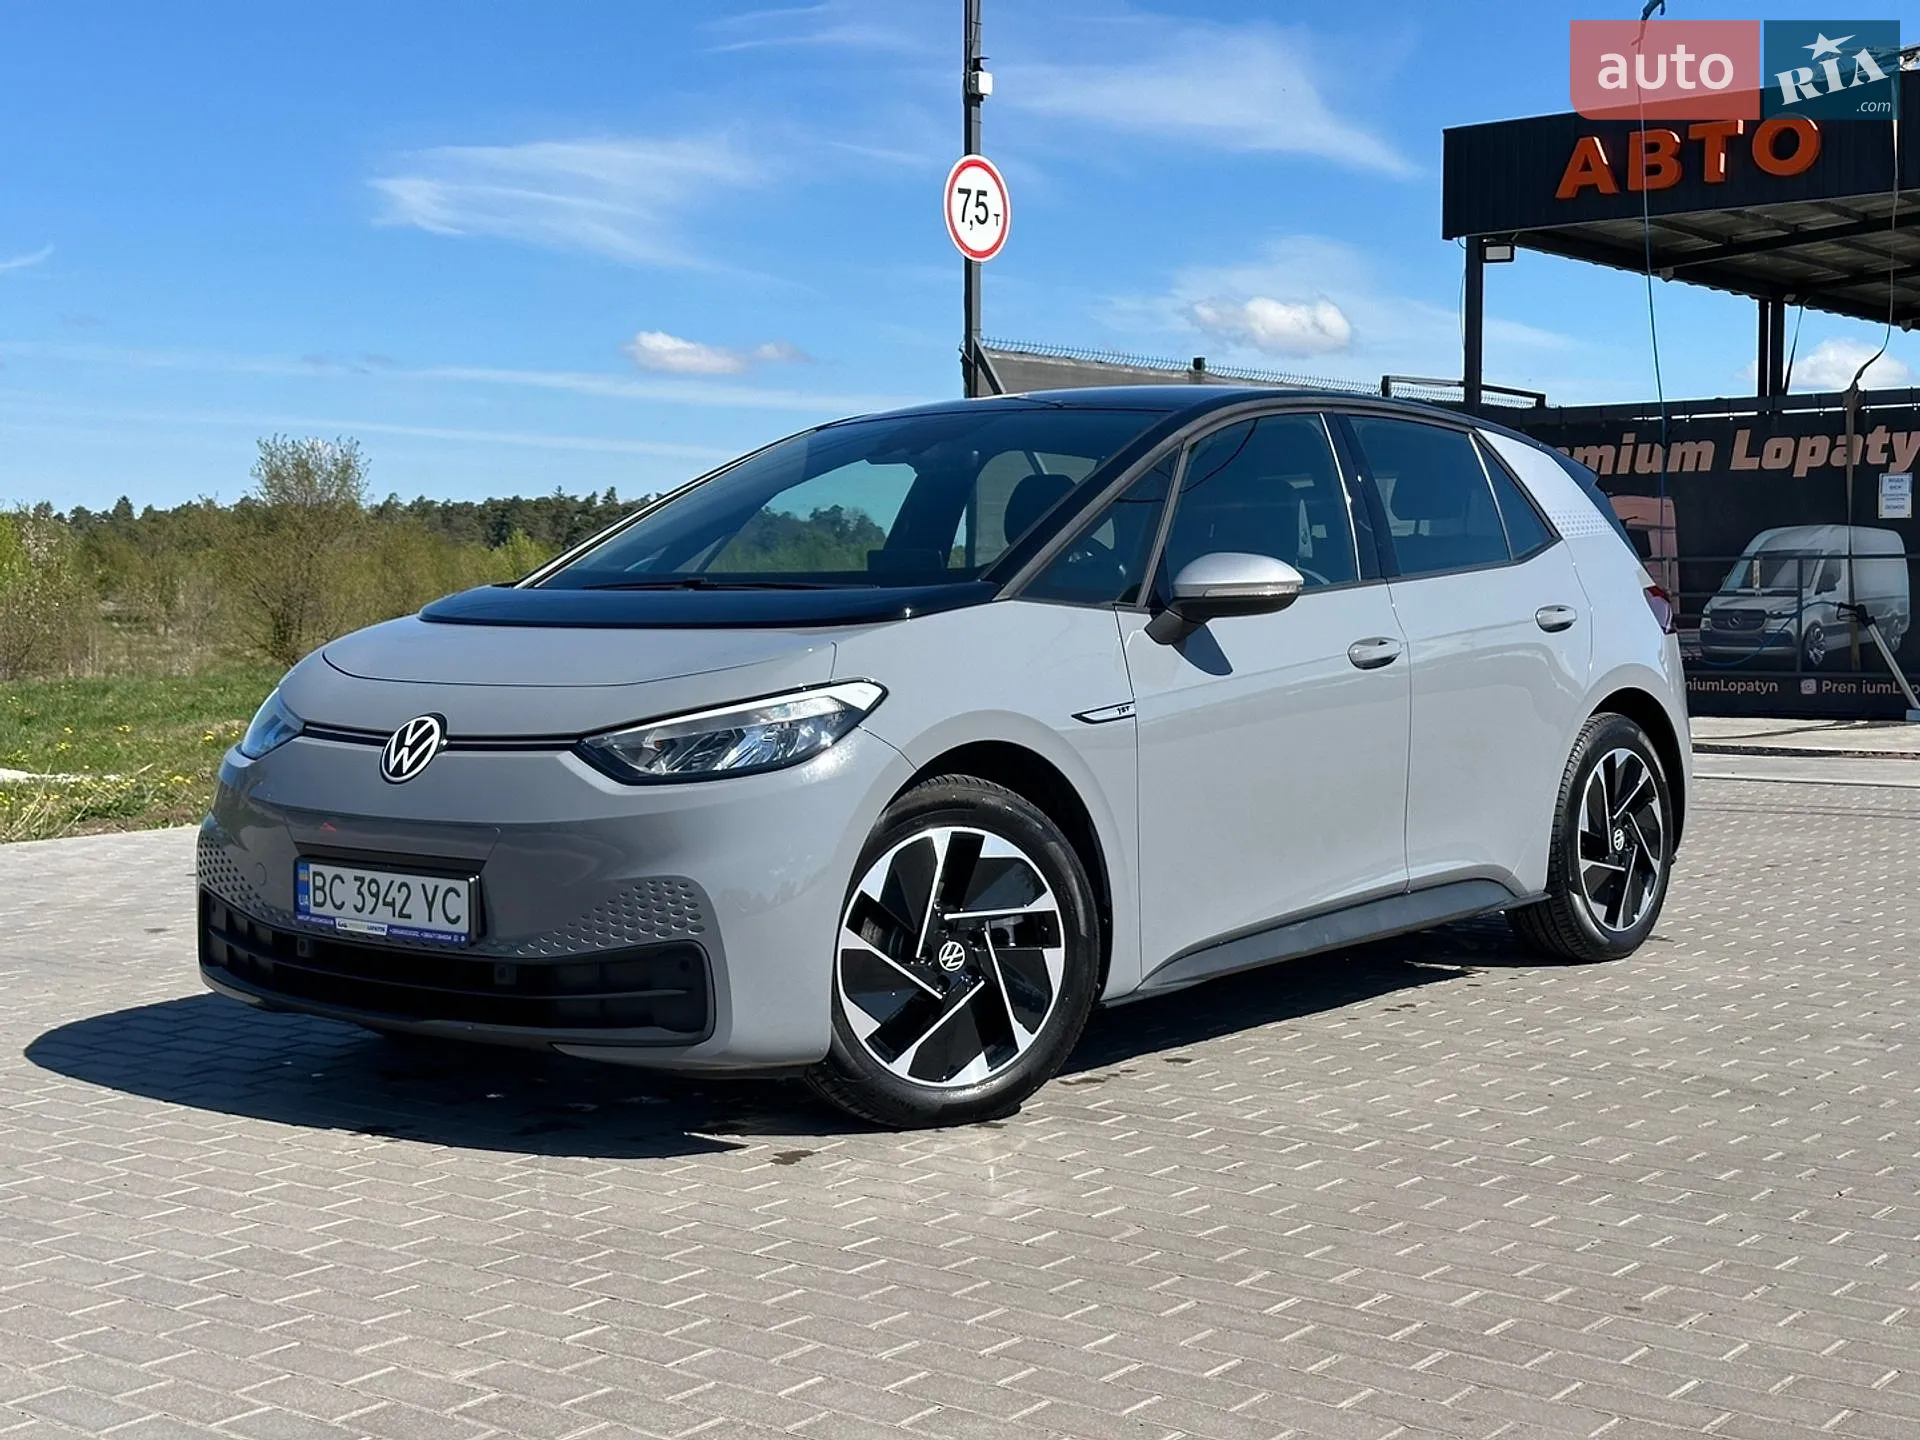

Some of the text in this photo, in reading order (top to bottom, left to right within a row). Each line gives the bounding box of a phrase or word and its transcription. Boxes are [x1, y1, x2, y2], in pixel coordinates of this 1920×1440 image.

[1555, 112, 1822, 200] АВТО
[957, 187, 989, 230] 7,5
[381, 716, 440, 782] VW
[312, 871, 462, 925] BC 3942 YC
